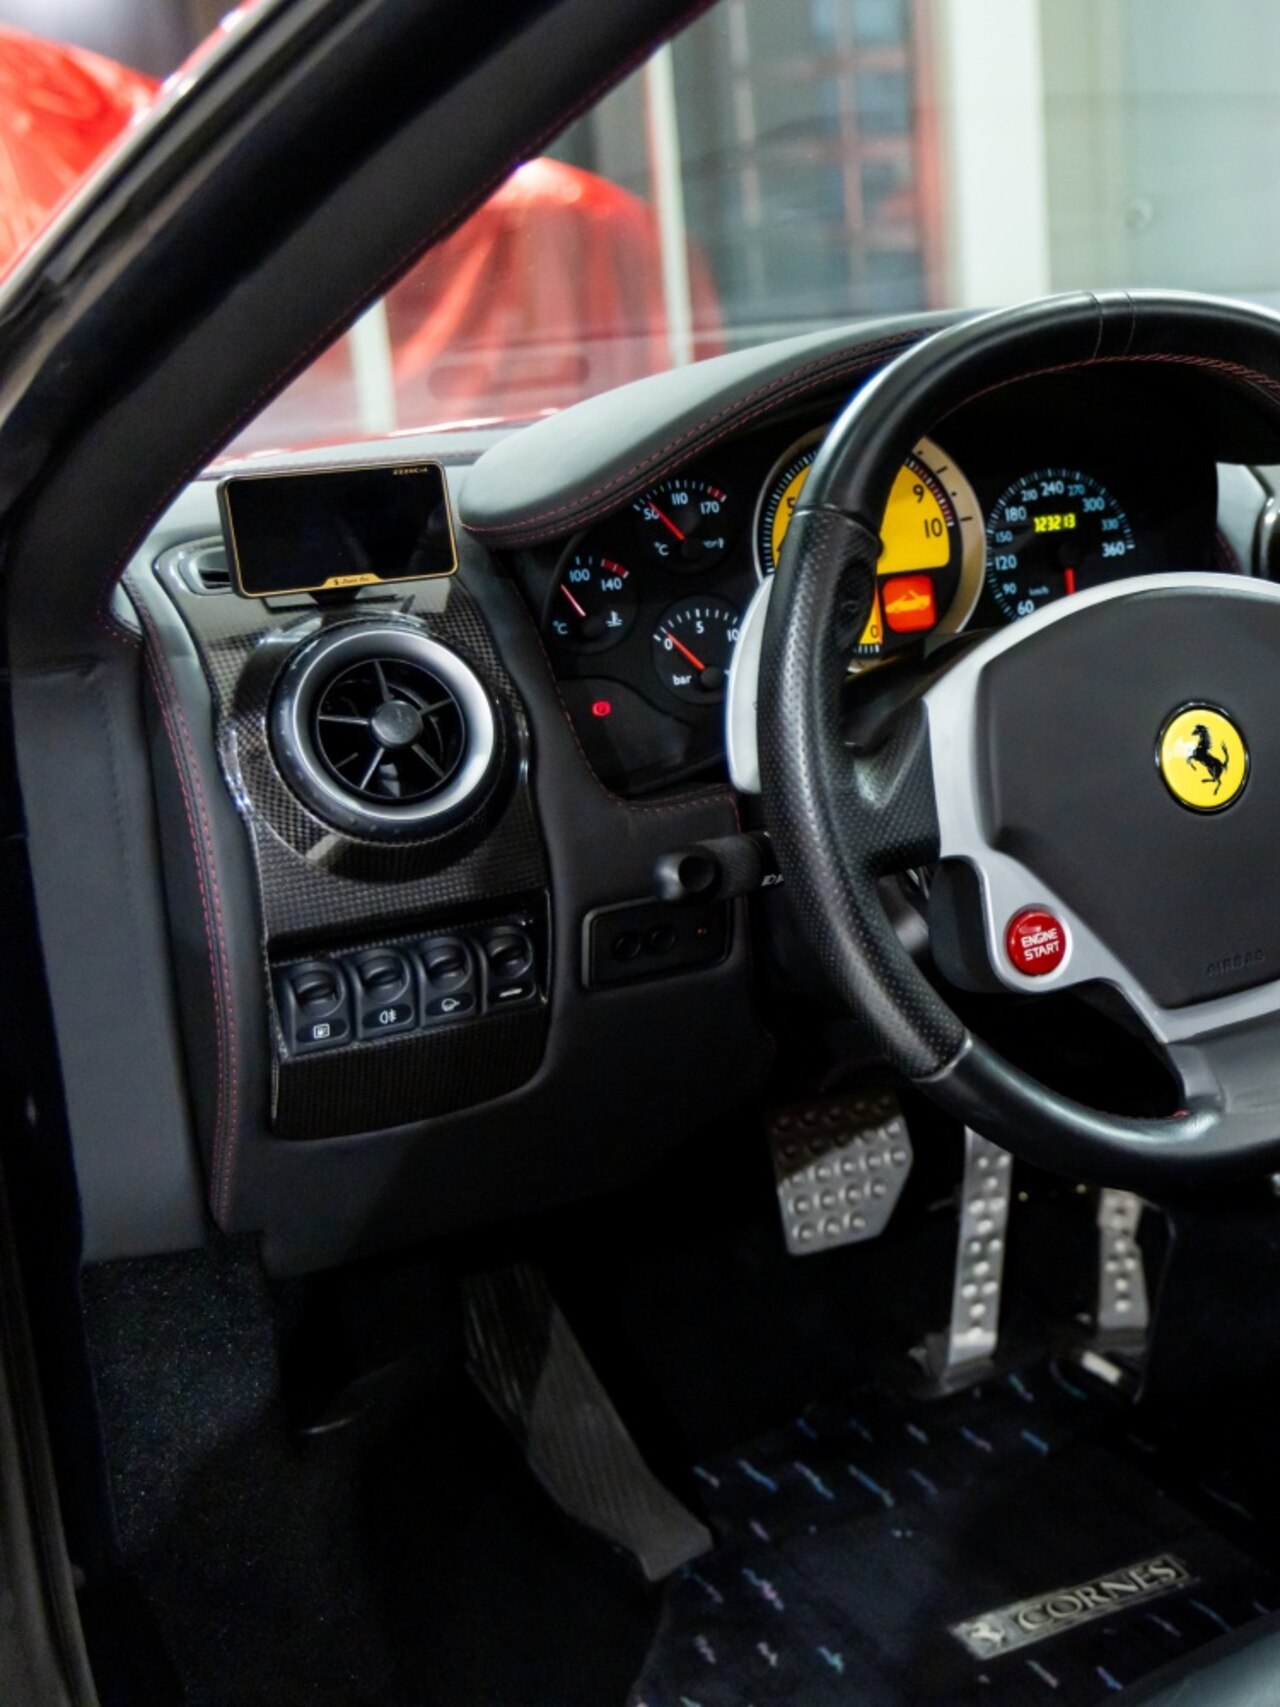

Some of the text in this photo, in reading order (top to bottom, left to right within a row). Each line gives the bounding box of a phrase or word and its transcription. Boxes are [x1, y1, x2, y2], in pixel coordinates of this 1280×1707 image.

[912, 484, 924, 503] 9
[1040, 481, 1064, 496] 240
[671, 493, 688, 505] 110
[1083, 497, 1105, 512] 300
[700, 502, 720, 514] 170
[1005, 507, 1027, 522] 180
[924, 518, 943, 538] 10
[995, 531, 1013, 542] 150
[1102, 541, 1125, 557] 360
[995, 555, 1017, 570] 120
[569, 569, 590, 582] 100
[601, 578, 622, 591] 140
[1002, 583, 1016, 594] 90
[1017, 600, 1034, 615] 60
[696, 621, 704, 633] 5
[870, 625, 879, 637] 0
[727, 629, 741, 642] 10
[664, 638, 673, 650] 0
[672, 675, 692, 685] bar
[1021, 928, 1058, 948] ENGINE
[1024, 941, 1059, 961] START
[1016, 1559, 1177, 1630] CORNES
